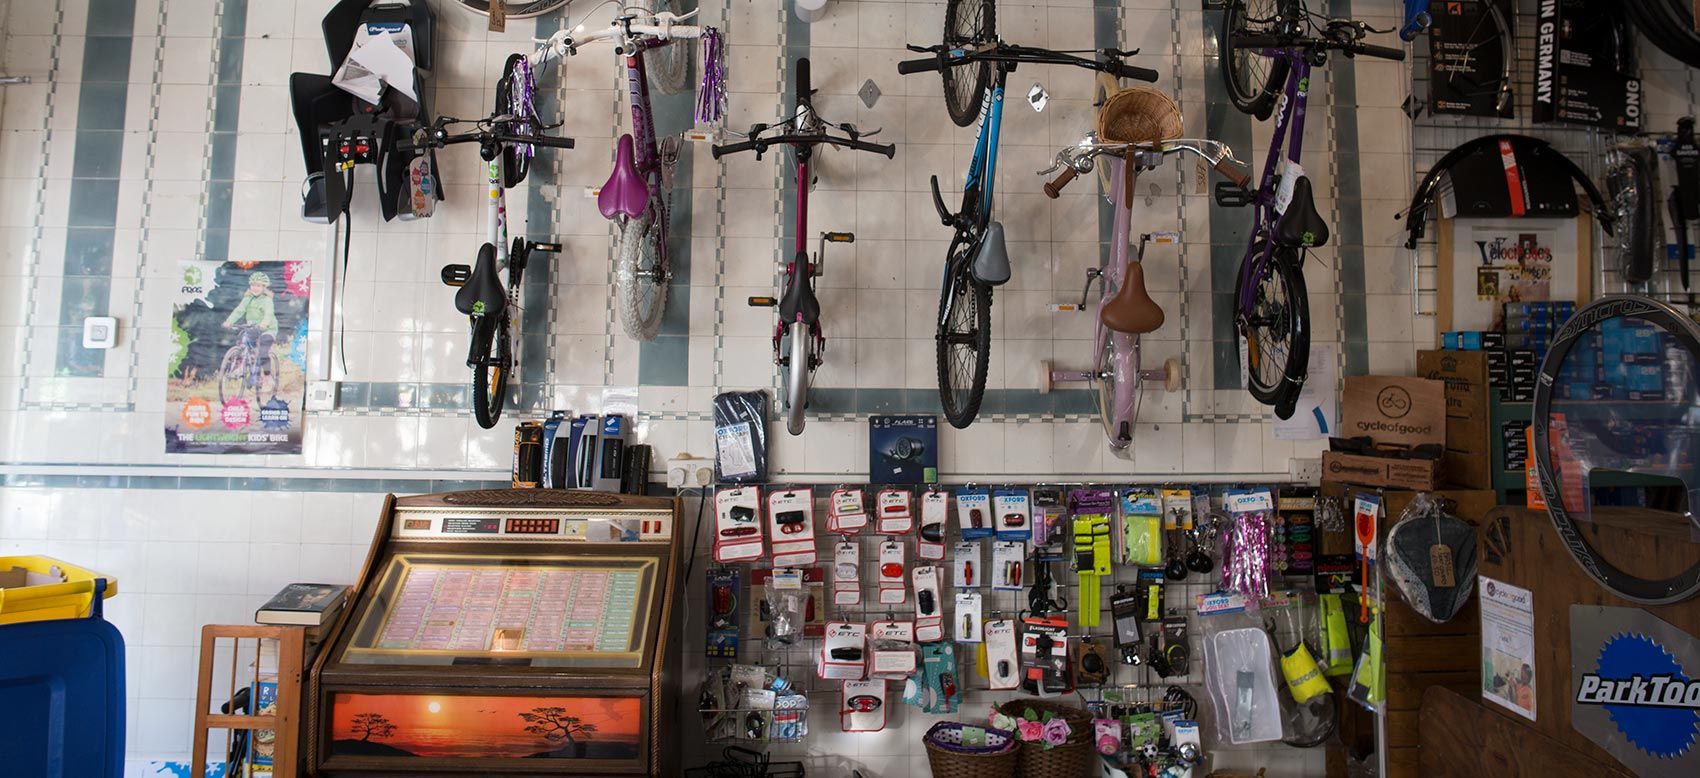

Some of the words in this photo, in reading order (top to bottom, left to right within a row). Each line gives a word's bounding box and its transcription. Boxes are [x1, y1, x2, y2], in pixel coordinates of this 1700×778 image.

[1537, 22, 1554, 104] GERMANY
[1625, 80, 1640, 128] LONG
[1356, 420, 1431, 434] cycleofgood
[177, 433, 194, 441] THE
[1237, 496, 1265, 504] OXFOD
